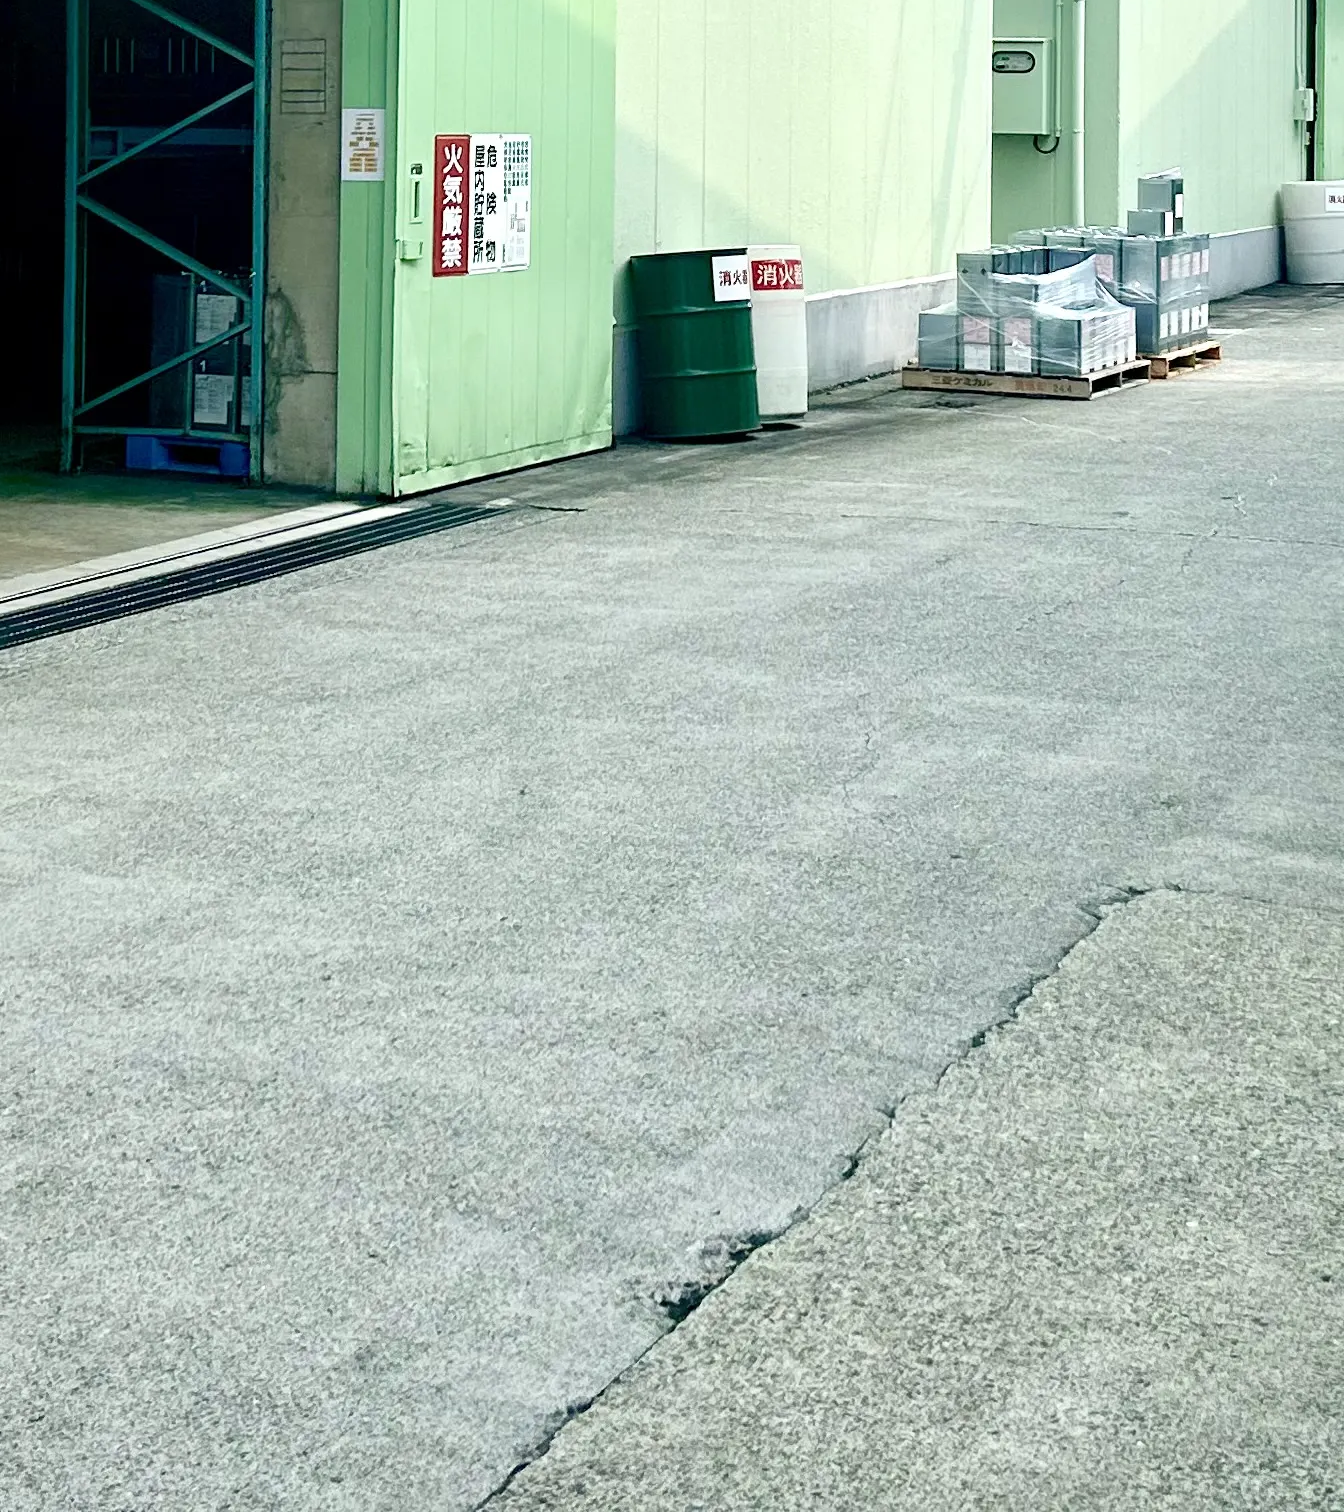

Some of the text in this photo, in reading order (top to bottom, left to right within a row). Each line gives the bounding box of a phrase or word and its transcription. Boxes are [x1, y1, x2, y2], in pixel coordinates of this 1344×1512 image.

[441, 144, 463, 268] 火気厳禁
[473, 145, 485, 263] 屋内貯蔵所
[486, 144, 497, 262] 危険物
